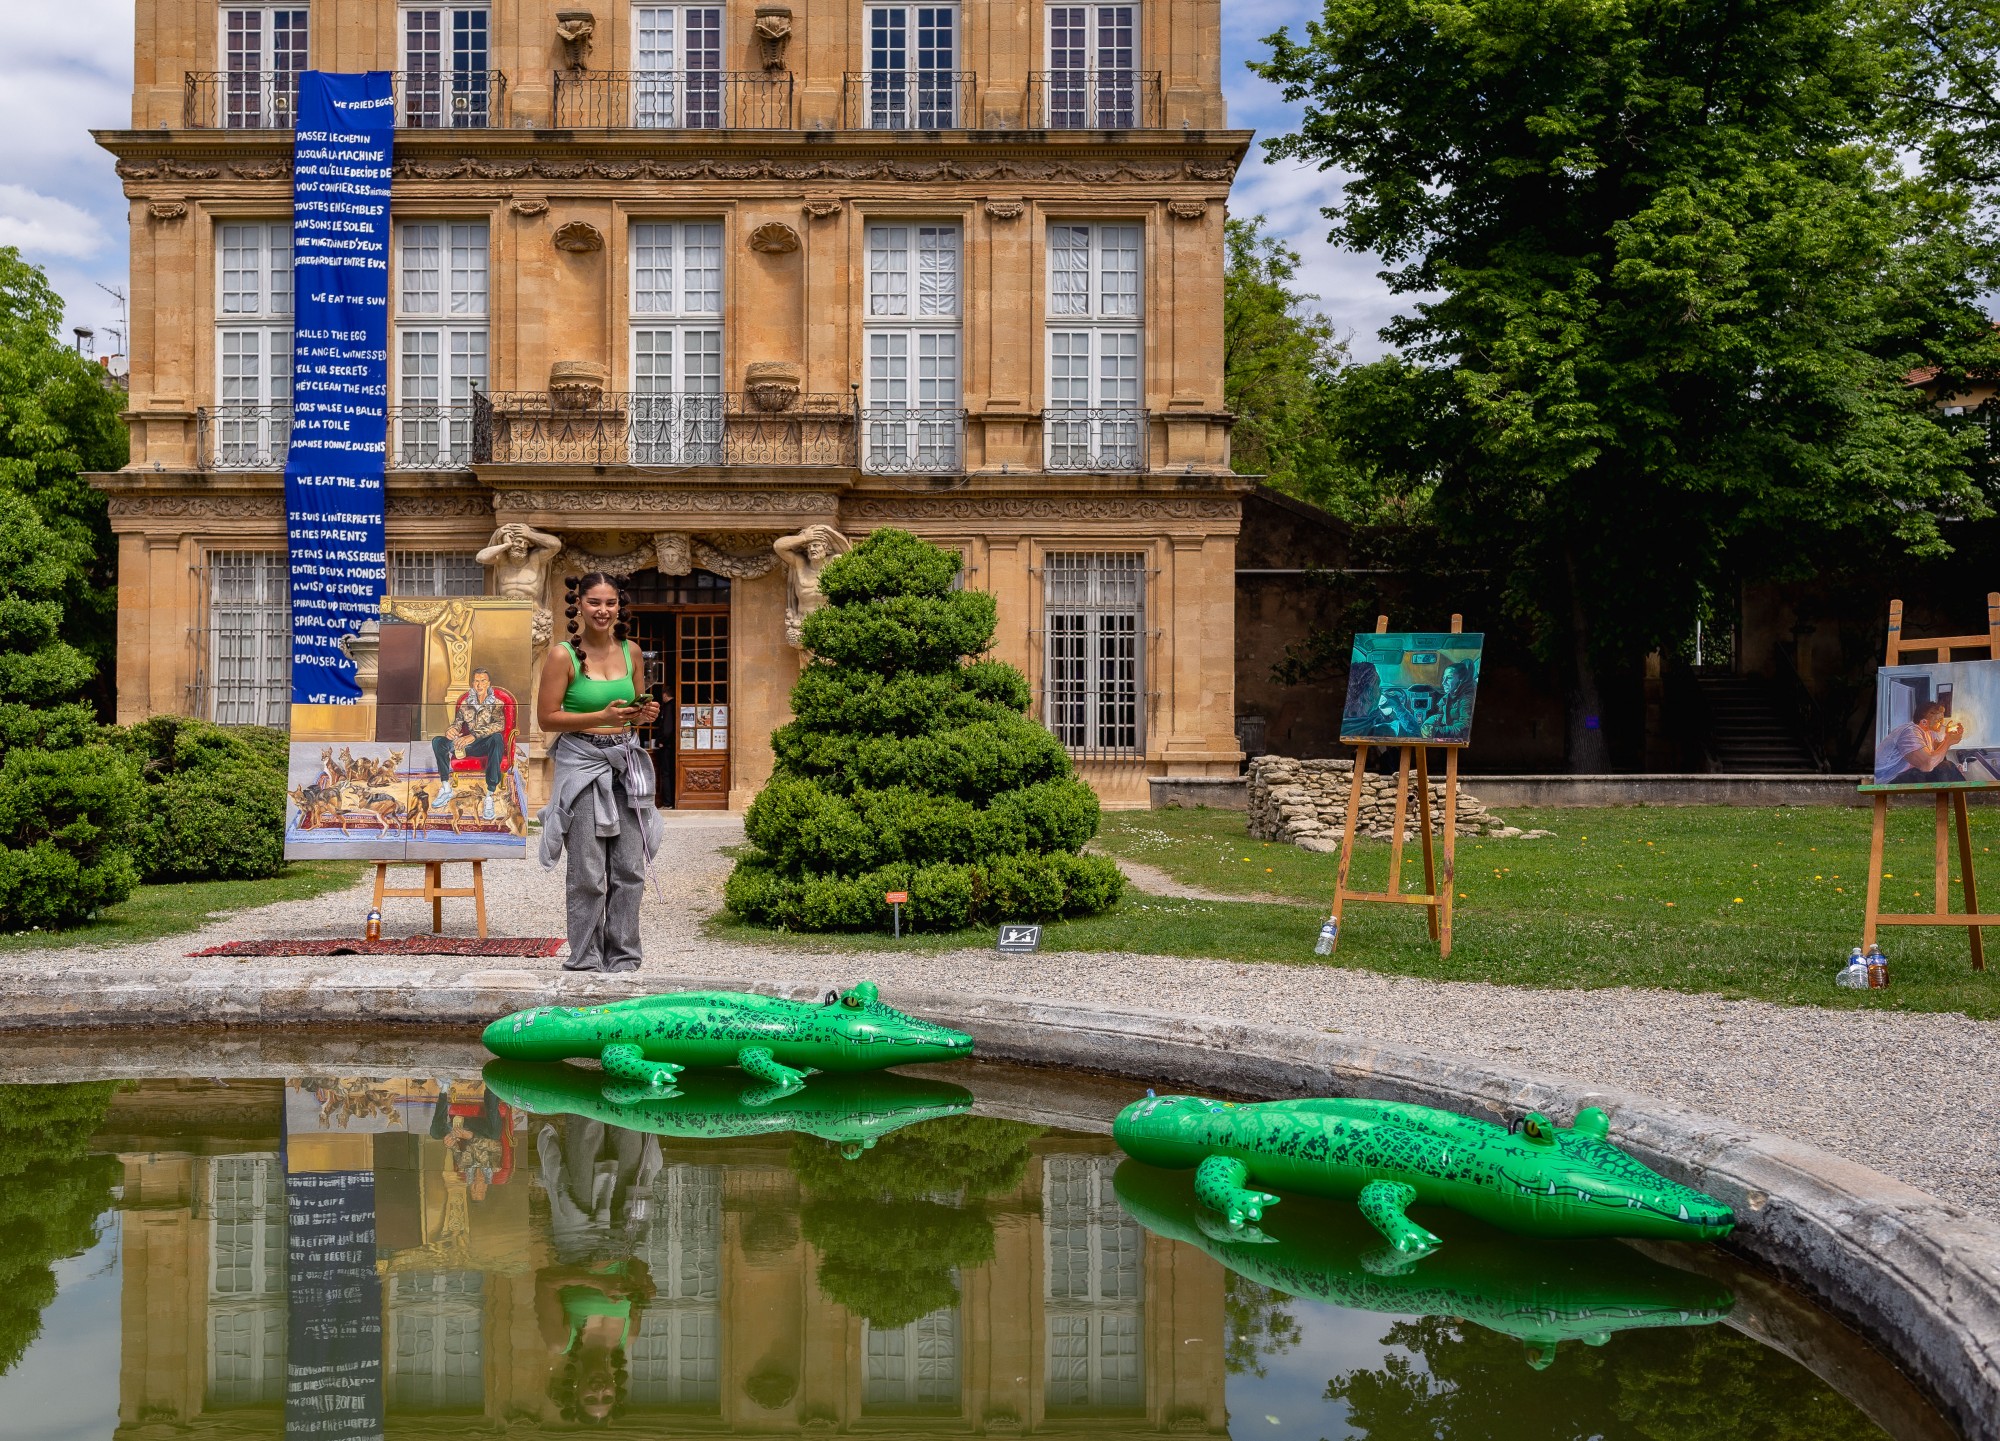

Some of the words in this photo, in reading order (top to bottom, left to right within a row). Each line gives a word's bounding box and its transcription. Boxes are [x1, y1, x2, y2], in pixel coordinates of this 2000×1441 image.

[334, 100, 347, 109] WE
[349, 101, 374, 110] FRIED
[375, 97, 394, 108] EGGS
[297, 131, 327, 142] PASSEZ
[296, 165, 317, 175] POUR
[380, 168, 391, 178] DE
[296, 182, 318, 192] VOUS
[332, 221, 342, 231] LE
[343, 221, 374, 233] SOLEIL
[367, 258, 386, 270] EUX
[312, 293, 326, 303] WE
[328, 295, 344, 304] EAT
[346, 296, 363, 305] THE
[366, 297, 386, 306] SUN
[331, 330, 348, 341] THE
[350, 330, 366, 341] EGG
[311, 347, 340, 358] ANGEL
[296, 364, 311, 374] ELL
[315, 365, 327, 374] UR
[329, 365, 368, 376] SECRETS
[342, 383, 360, 394] THE
[361, 384, 387, 396] MESS
[295, 402, 316, 412] LORS
[344, 405, 354, 414] LA
[355, 405, 382, 417] BALLE
[308, 420, 320, 429] LA
[322, 419, 350, 431] TOILE
[297, 476, 312, 486] WE
[315, 476, 335, 486] EAT
[336, 477, 355, 488] THE
[359, 478, 380, 489] SUN
[290, 511, 300, 521] JE
[302, 511, 320, 522] SUIS
[290, 529, 301, 539] DE
[320, 529, 368, 543] PARENTS
[325, 550, 336, 560] LA
[292, 564, 318, 575] ENTRE
[319, 566, 344, 578] DEUX
[346, 567, 386, 580] MONDES
[293, 582, 300, 592] A
[300, 581, 324, 592] WISP
[325, 583, 336, 593] OF
[337, 583, 373, 597] SMOKE
[328, 601, 339, 612] UP
[294, 615, 325, 627] SPIRAL
[326, 618, 347, 629] OUT
[295, 634, 314, 645] NON
[314, 635, 327, 647] JE
[294, 654, 337, 667] EPOUSER
[338, 658, 351, 669] LA
[308, 693, 327, 704] WE
